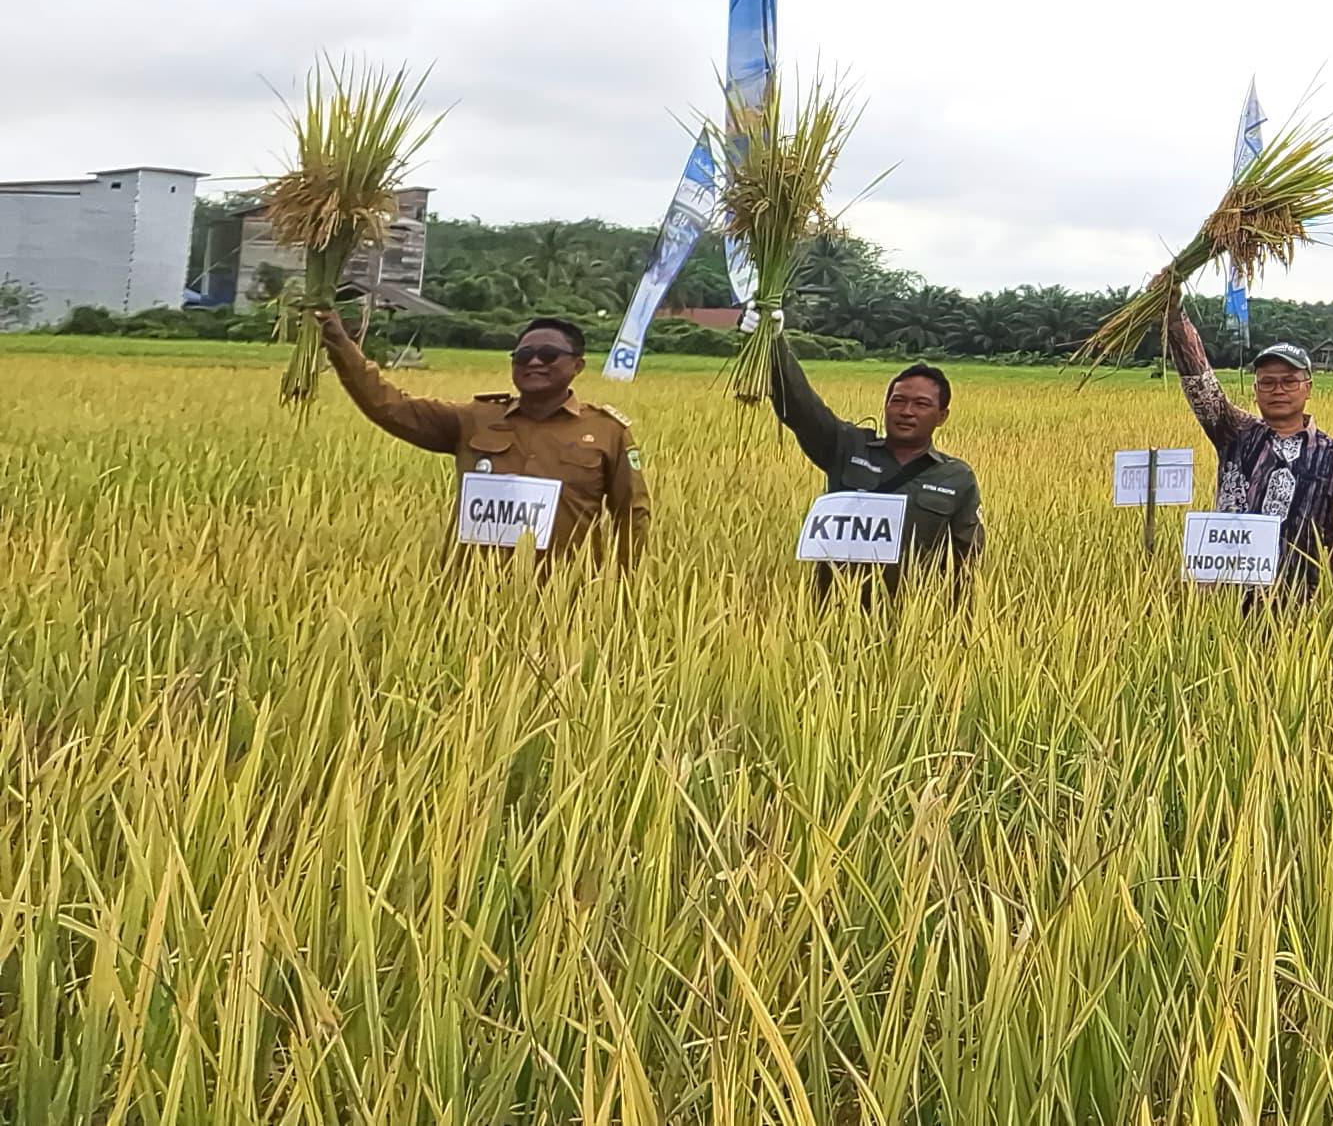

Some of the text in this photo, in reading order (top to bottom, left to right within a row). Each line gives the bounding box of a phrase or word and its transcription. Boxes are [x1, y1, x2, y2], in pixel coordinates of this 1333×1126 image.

[469, 498, 546, 526] CAMAT
[809, 514, 892, 542] KTNA
[1208, 529, 1252, 545] BANK
[1186, 554, 1272, 572] INDONESIA
